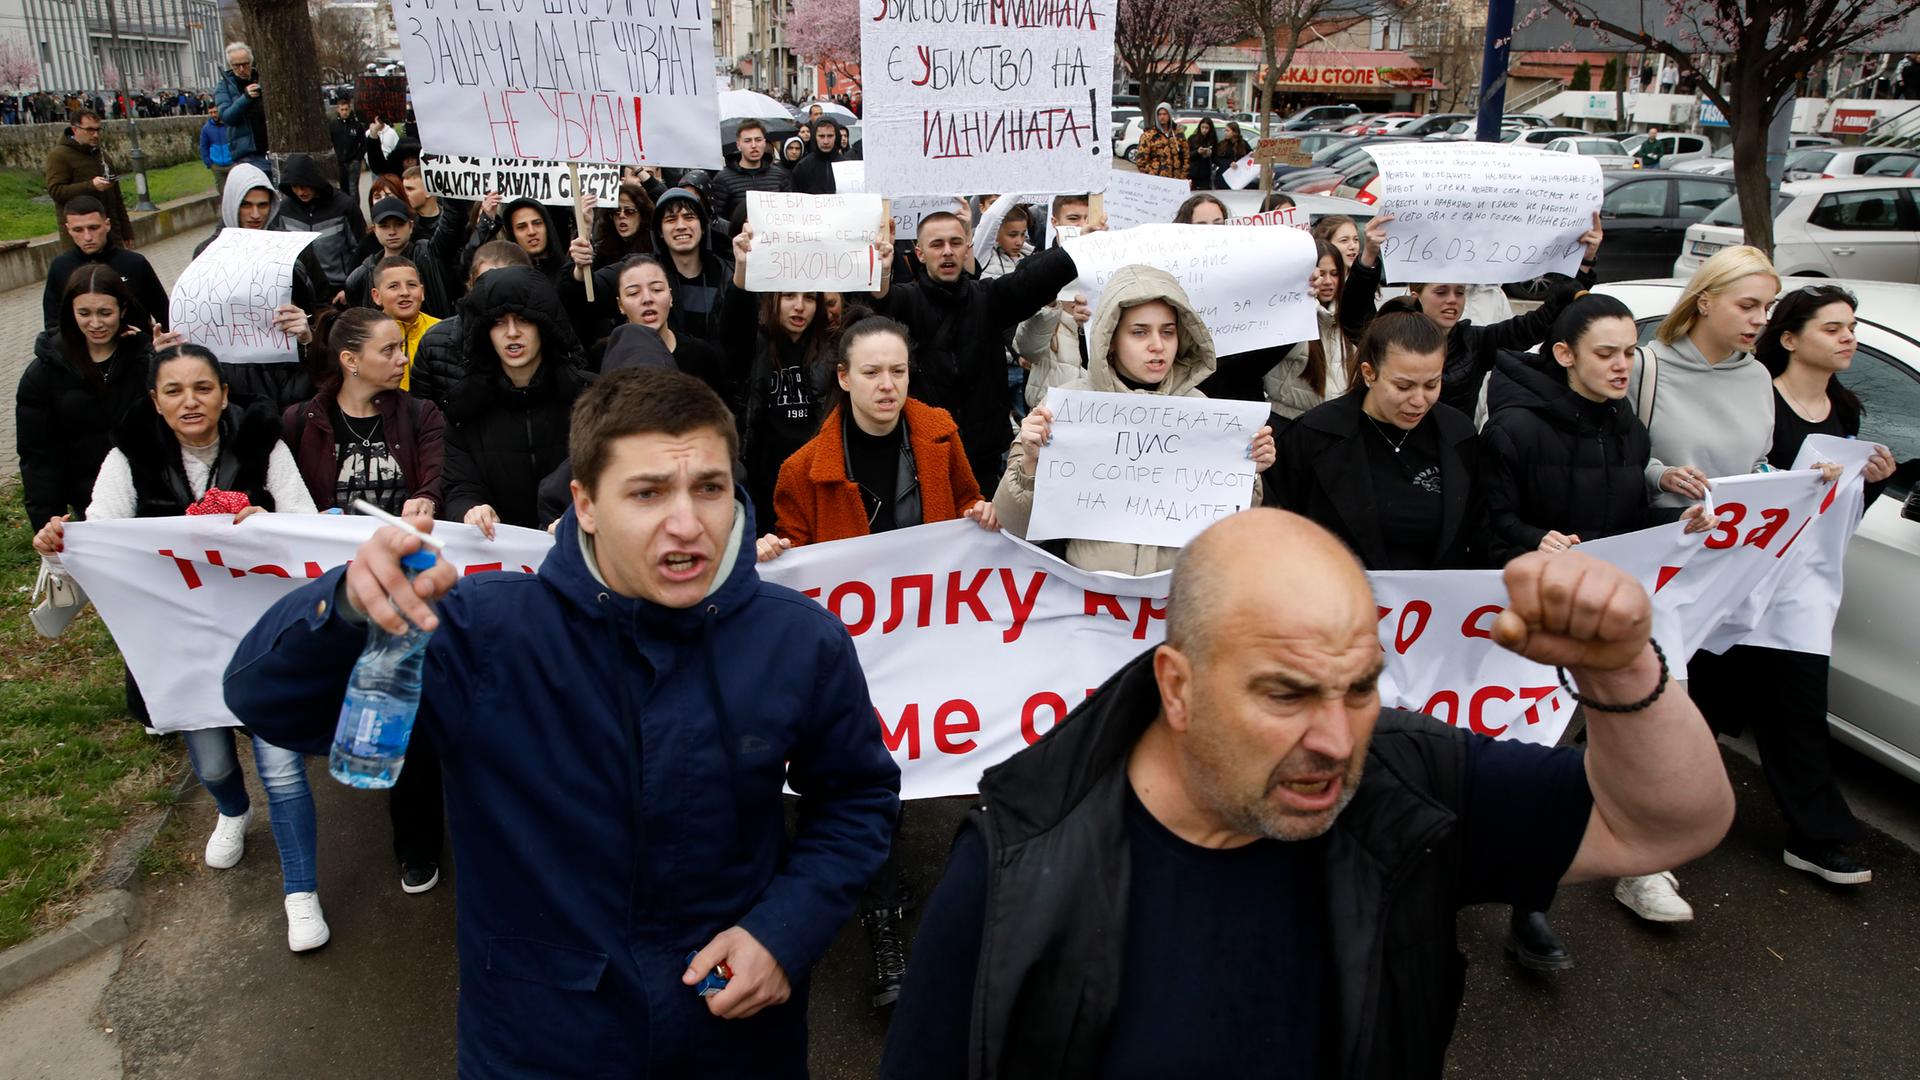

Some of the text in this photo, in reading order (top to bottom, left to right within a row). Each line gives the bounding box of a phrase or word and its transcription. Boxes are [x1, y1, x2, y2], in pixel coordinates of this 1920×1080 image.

[409, 17, 528, 88] ЗАДАЧА
[533, 20, 574, 92] ДА
[574, 17, 616, 93] НЕ
[911, 45, 1033, 91] УБИСТВО
[1051, 47, 1091, 89] НА
[1321, 68, 1374, 84] СТОЛЕ
[483, 88, 539, 159] НЕ
[538, 91, 646, 164] УБИЈА!
[923, 88, 1100, 160] ИДНИНАТА!
[424, 169, 491, 196] ПОДИГНЕ
[497, 171, 551, 200] ВАШАТА
[759, 195, 778, 208] НЕ
[786, 196, 804, 208] БИ
[760, 231, 780, 247] ДА
[787, 231, 822, 244] БЕШЕ
[836, 230, 852, 241] СЕ
[765, 244, 875, 286] ЗАКОНОТ!
[1055, 398, 1243, 432] ДИСКОТЕКАТА
[1115, 431, 1181, 461] ПУЛС
[1049, 461, 1254, 492] ГО СОПРЕ ПУЛСОТ
[1076, 492, 1107, 510] НА
[800, 567, 1048, 644] олку
